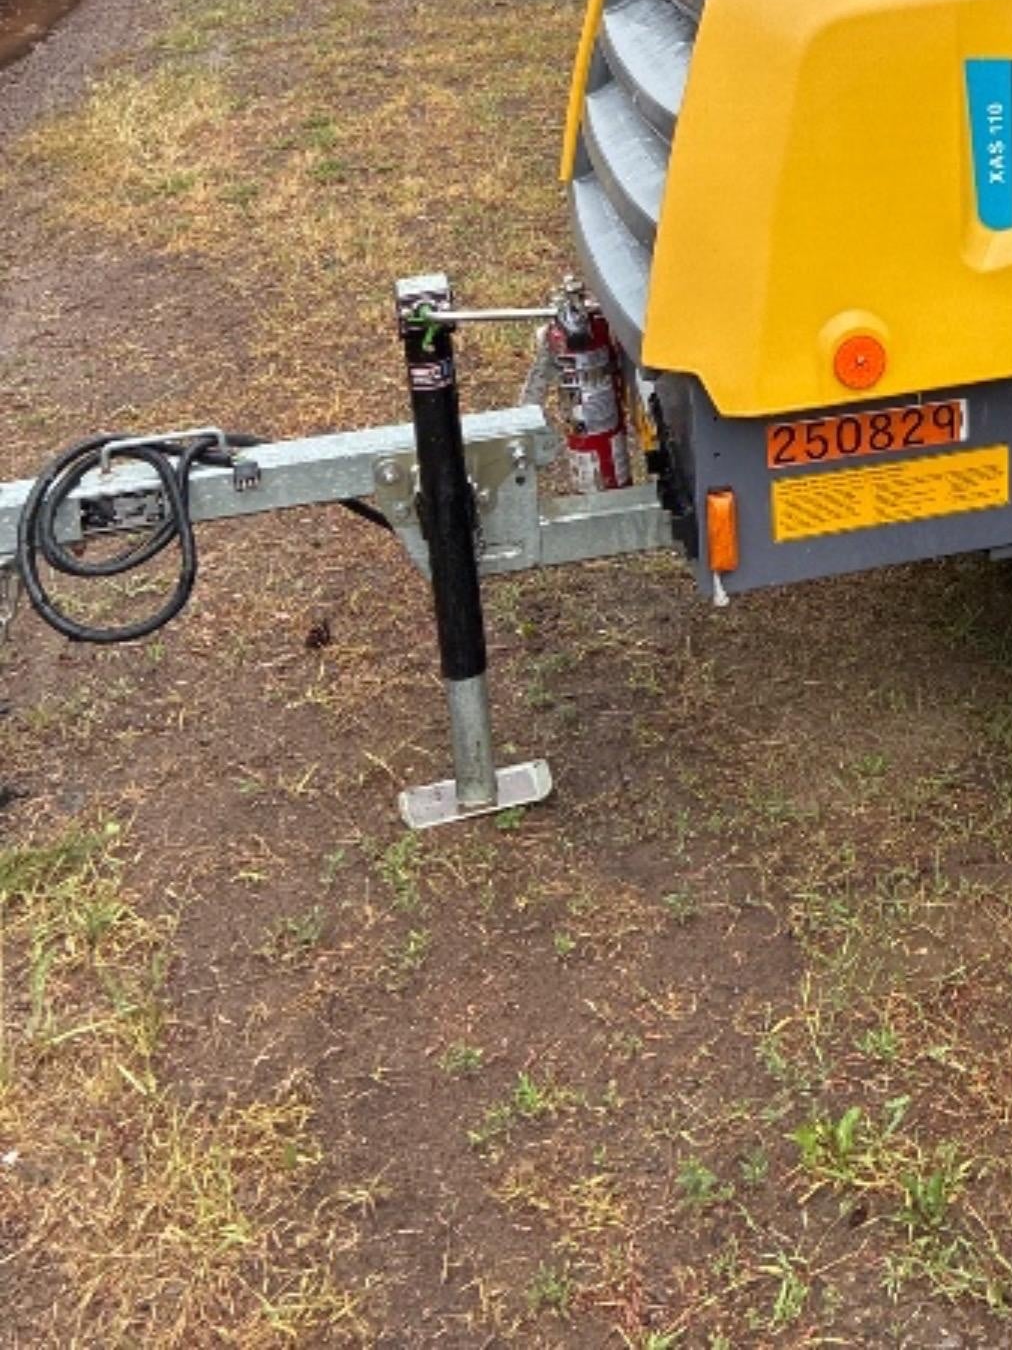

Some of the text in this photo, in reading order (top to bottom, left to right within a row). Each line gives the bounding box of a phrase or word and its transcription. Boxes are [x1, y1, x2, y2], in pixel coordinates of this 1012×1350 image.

[986, 103, 1006, 184] XAS 110
[772, 404, 955, 465] 250829
